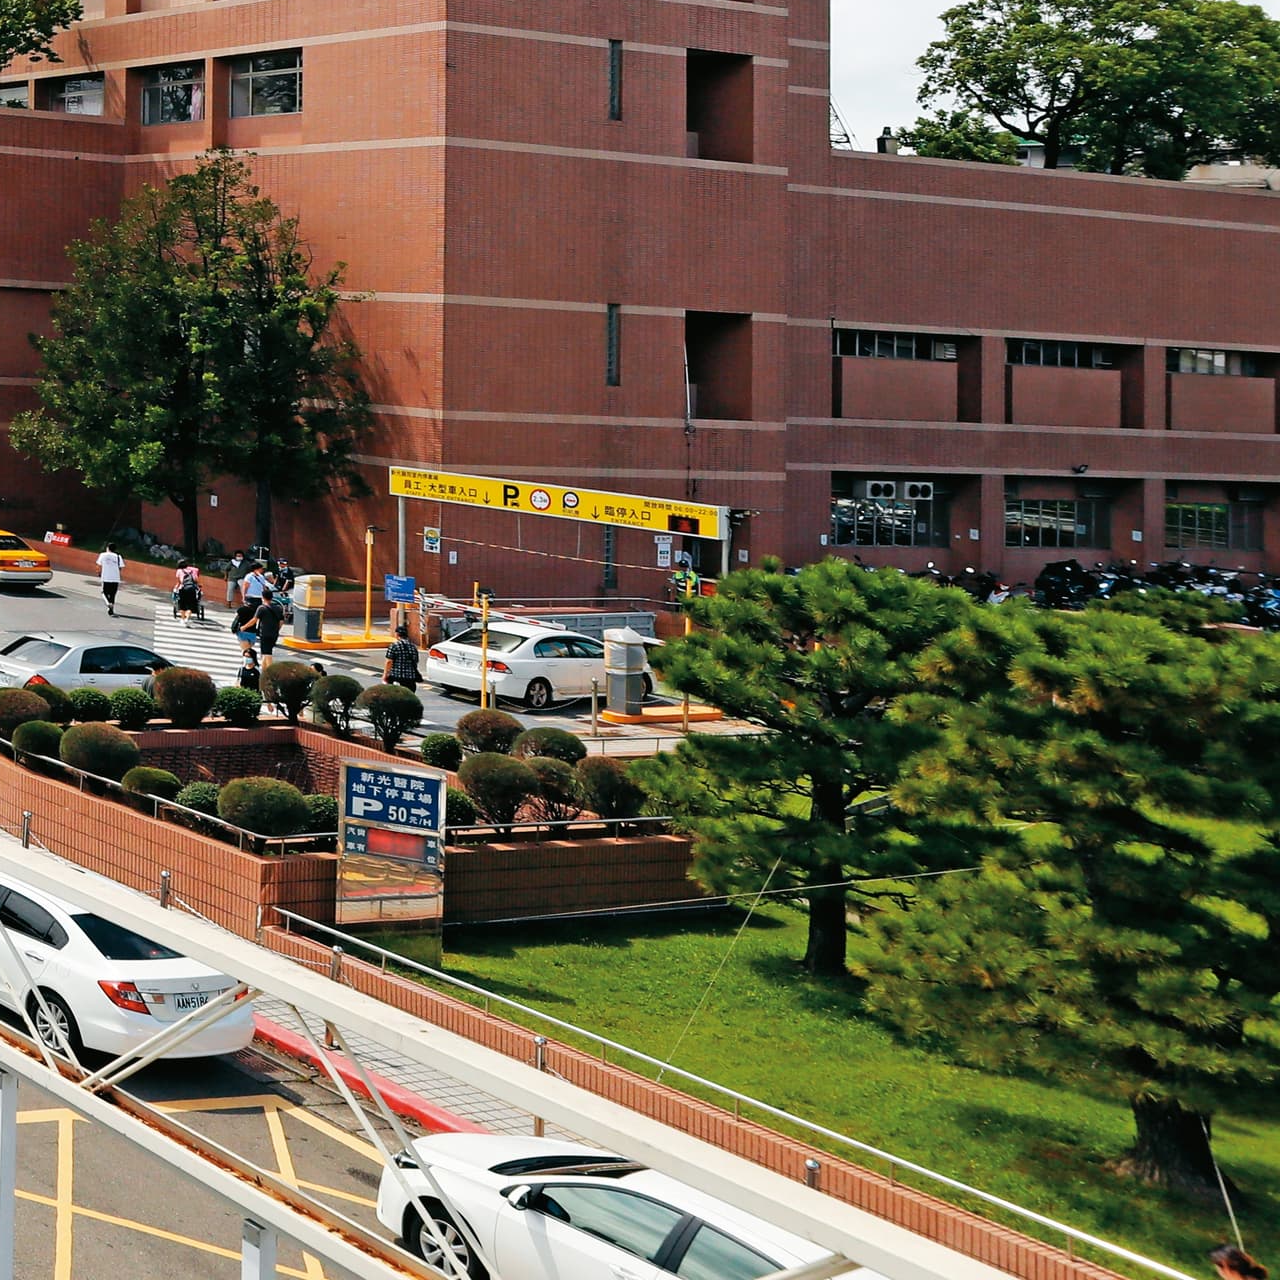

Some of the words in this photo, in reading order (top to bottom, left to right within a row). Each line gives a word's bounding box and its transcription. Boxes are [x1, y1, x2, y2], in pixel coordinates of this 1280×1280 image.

[503, 484, 520, 506] P
[604, 505, 651, 521] 臨停入口
[360, 772, 425, 791] 新光醫院
[352, 782, 433, 805] 地下停車場
[352, 796, 383, 816] P
[388, 805, 407, 822] 50
